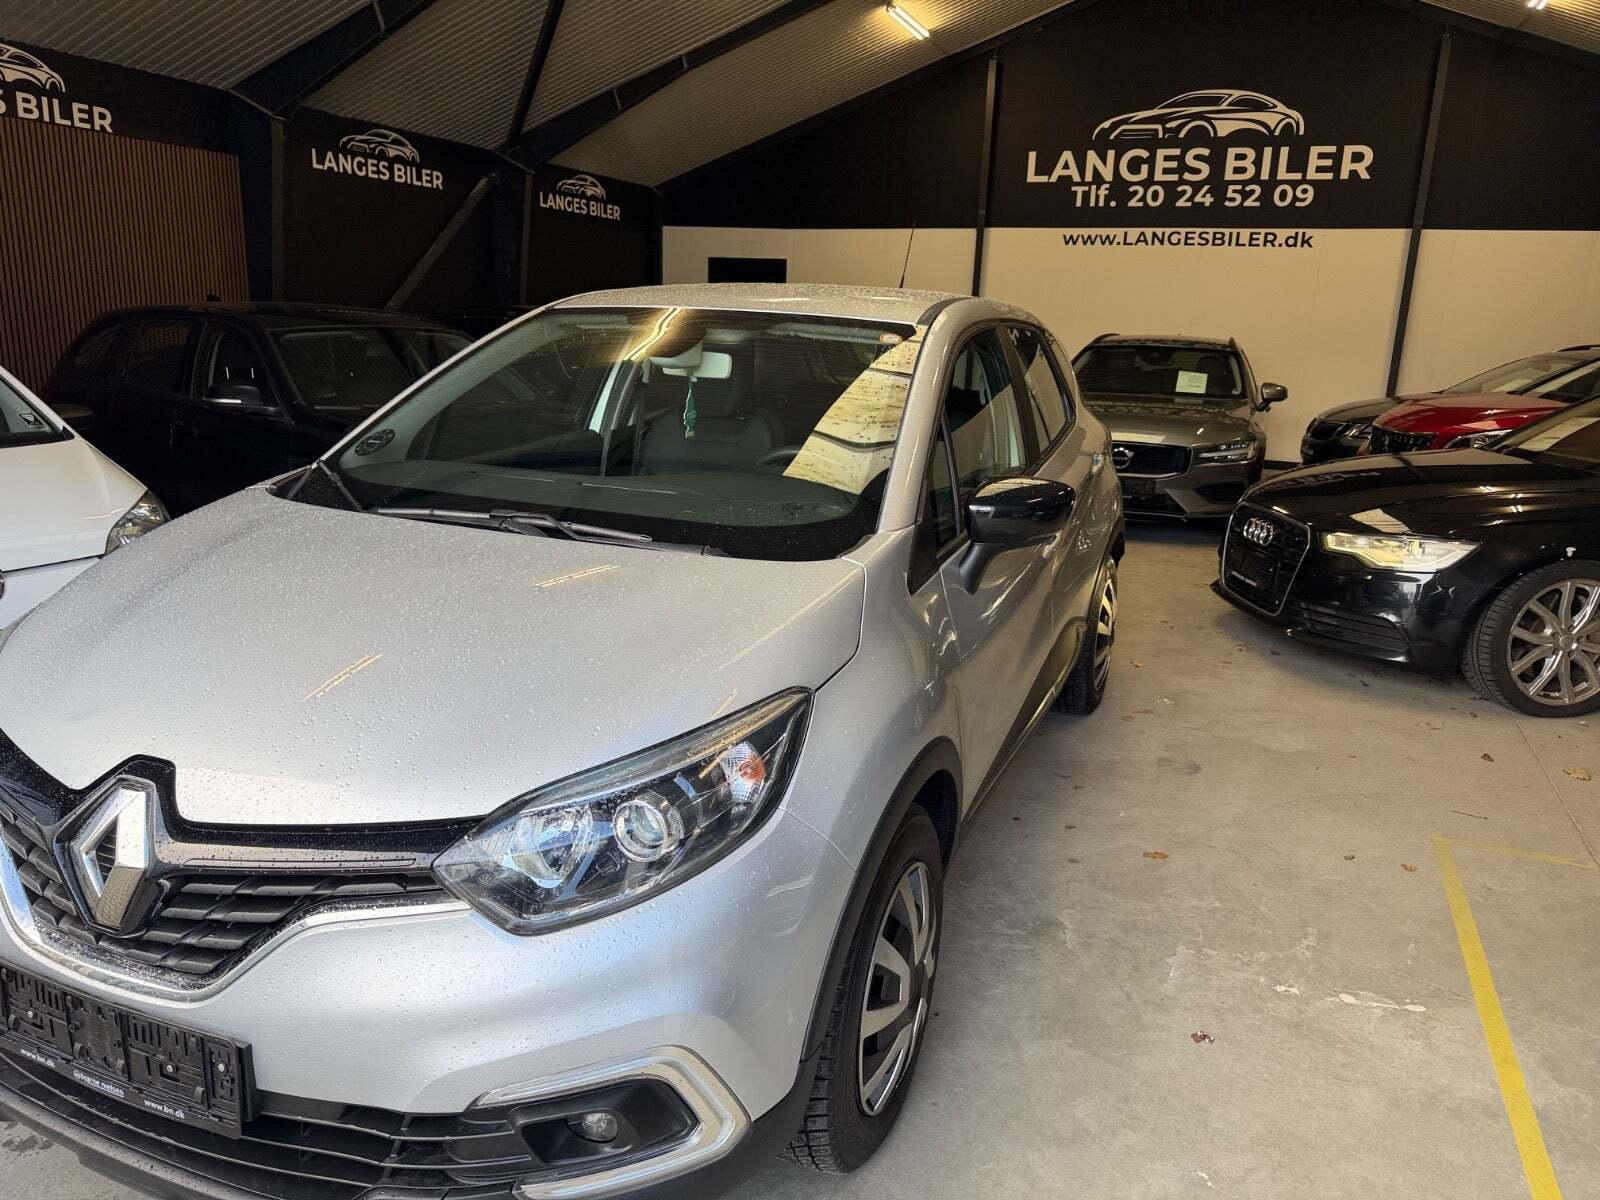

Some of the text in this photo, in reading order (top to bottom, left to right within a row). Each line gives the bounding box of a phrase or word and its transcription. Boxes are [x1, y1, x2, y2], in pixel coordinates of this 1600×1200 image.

[16, 91, 112, 133] BILER
[311, 148, 443, 190] LANGES BILER
[1027, 145, 1374, 183] LANGES BILER
[539, 191, 621, 220] LANGES BILER
[1071, 184, 1315, 207] Tlf. 20 24 52 09
[1062, 231, 1314, 248] www.LANGESBILER.dk
[20, 1049, 55, 1067] www.bn.dk
[144, 1099, 185, 1119] www.bn.dk
